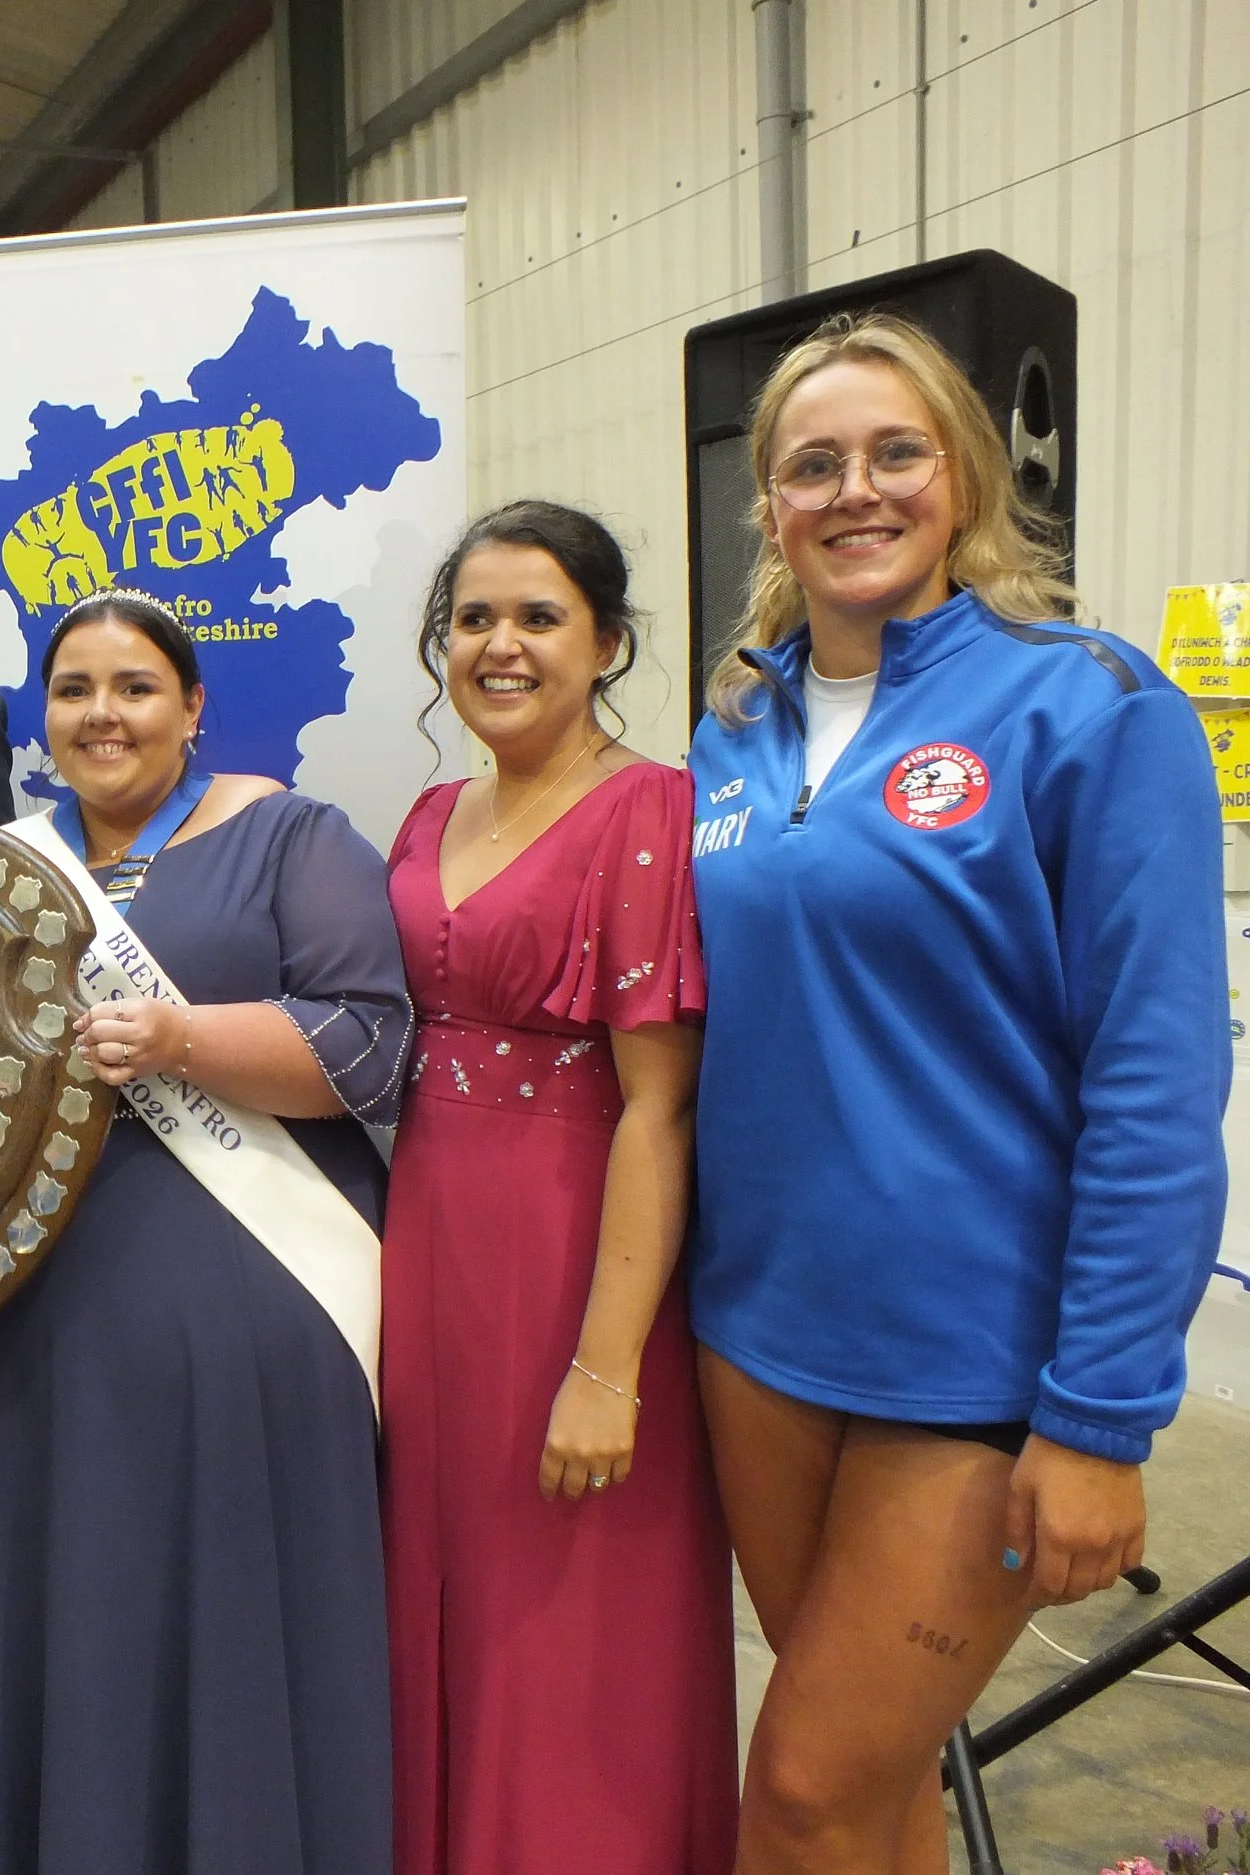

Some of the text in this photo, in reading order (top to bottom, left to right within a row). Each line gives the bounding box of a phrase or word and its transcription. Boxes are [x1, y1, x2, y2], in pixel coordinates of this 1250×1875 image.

[94, 511, 202, 574] YFC
[901, 747, 985, 786] FISHGUARD
[908, 784, 966, 799] NO BULL
[907, 812, 938, 827] YFC
[105, 931, 178, 1005] BREN
